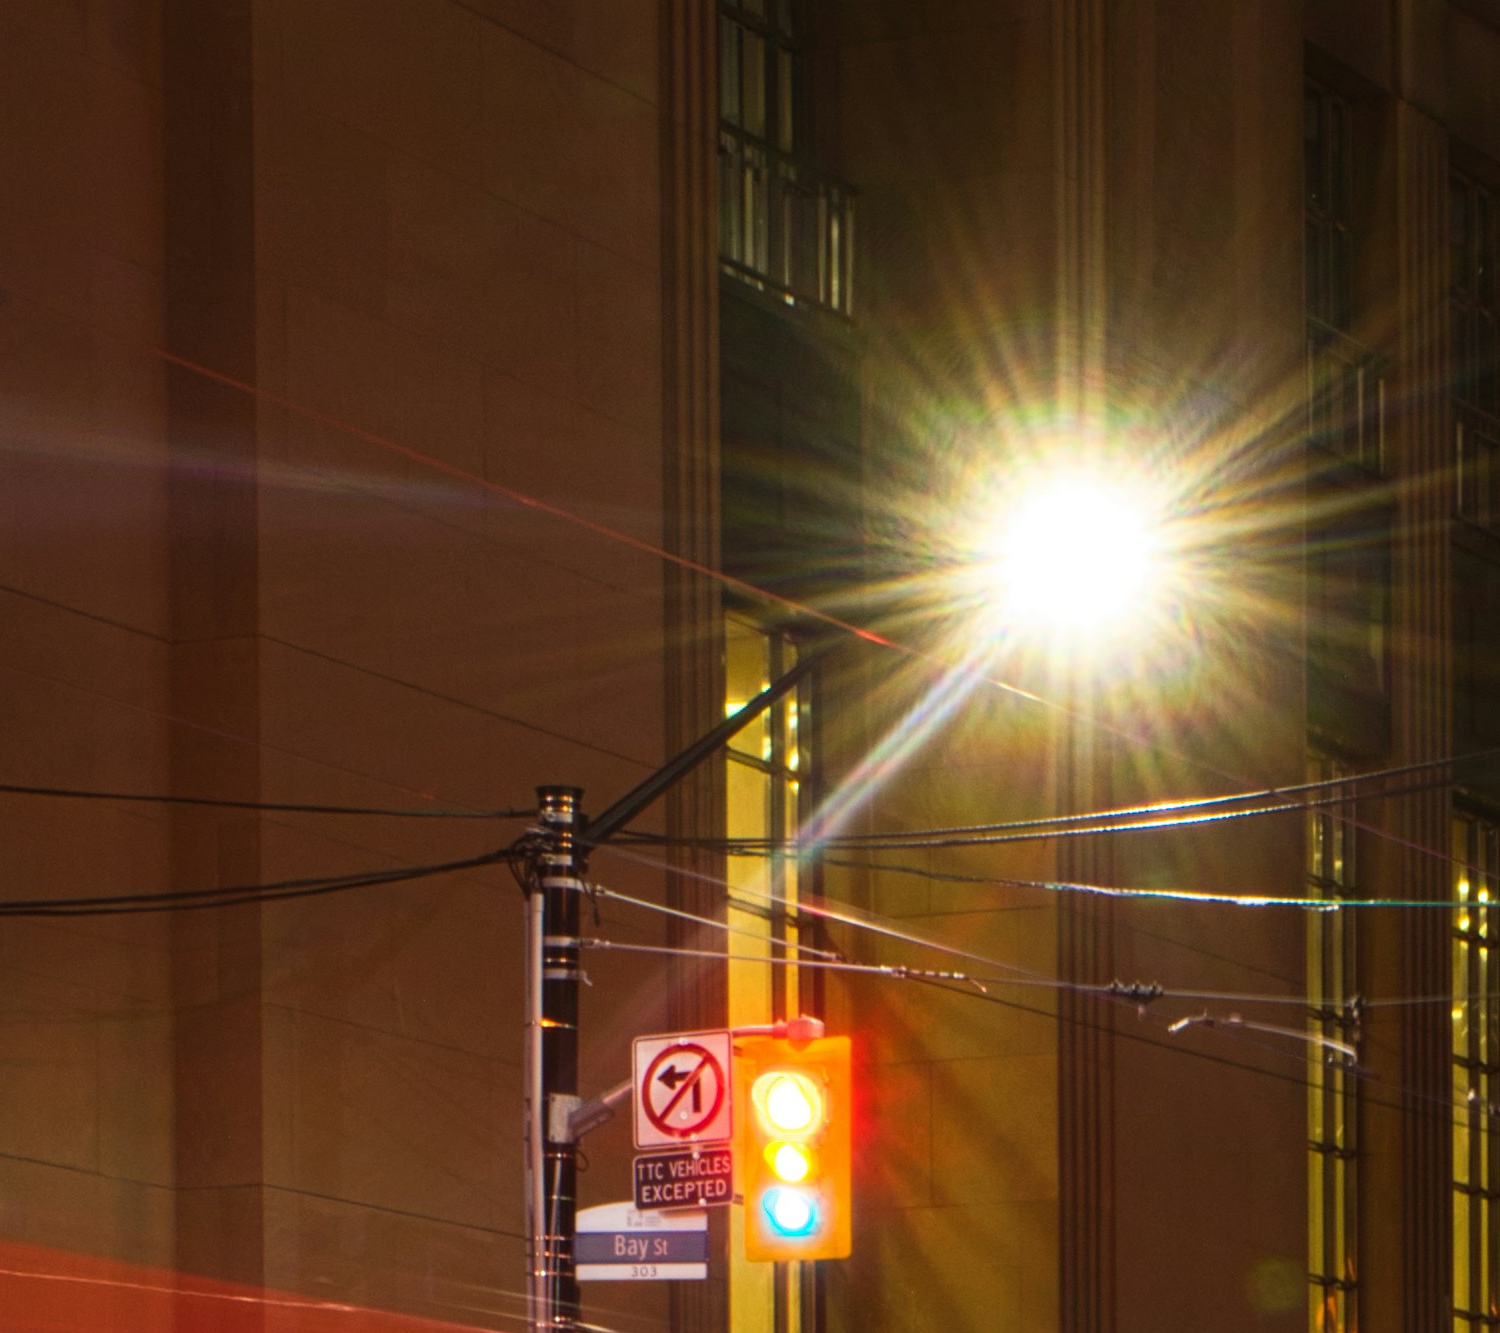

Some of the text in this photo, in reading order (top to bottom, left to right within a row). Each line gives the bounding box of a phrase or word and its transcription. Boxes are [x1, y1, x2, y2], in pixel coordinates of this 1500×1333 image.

[636, 1156, 731, 1182] TTC VEHICLES
[641, 1179, 727, 1204] EXCEPTED
[614, 1234, 669, 1261] Bay St
[631, 1266, 658, 1278] 303
